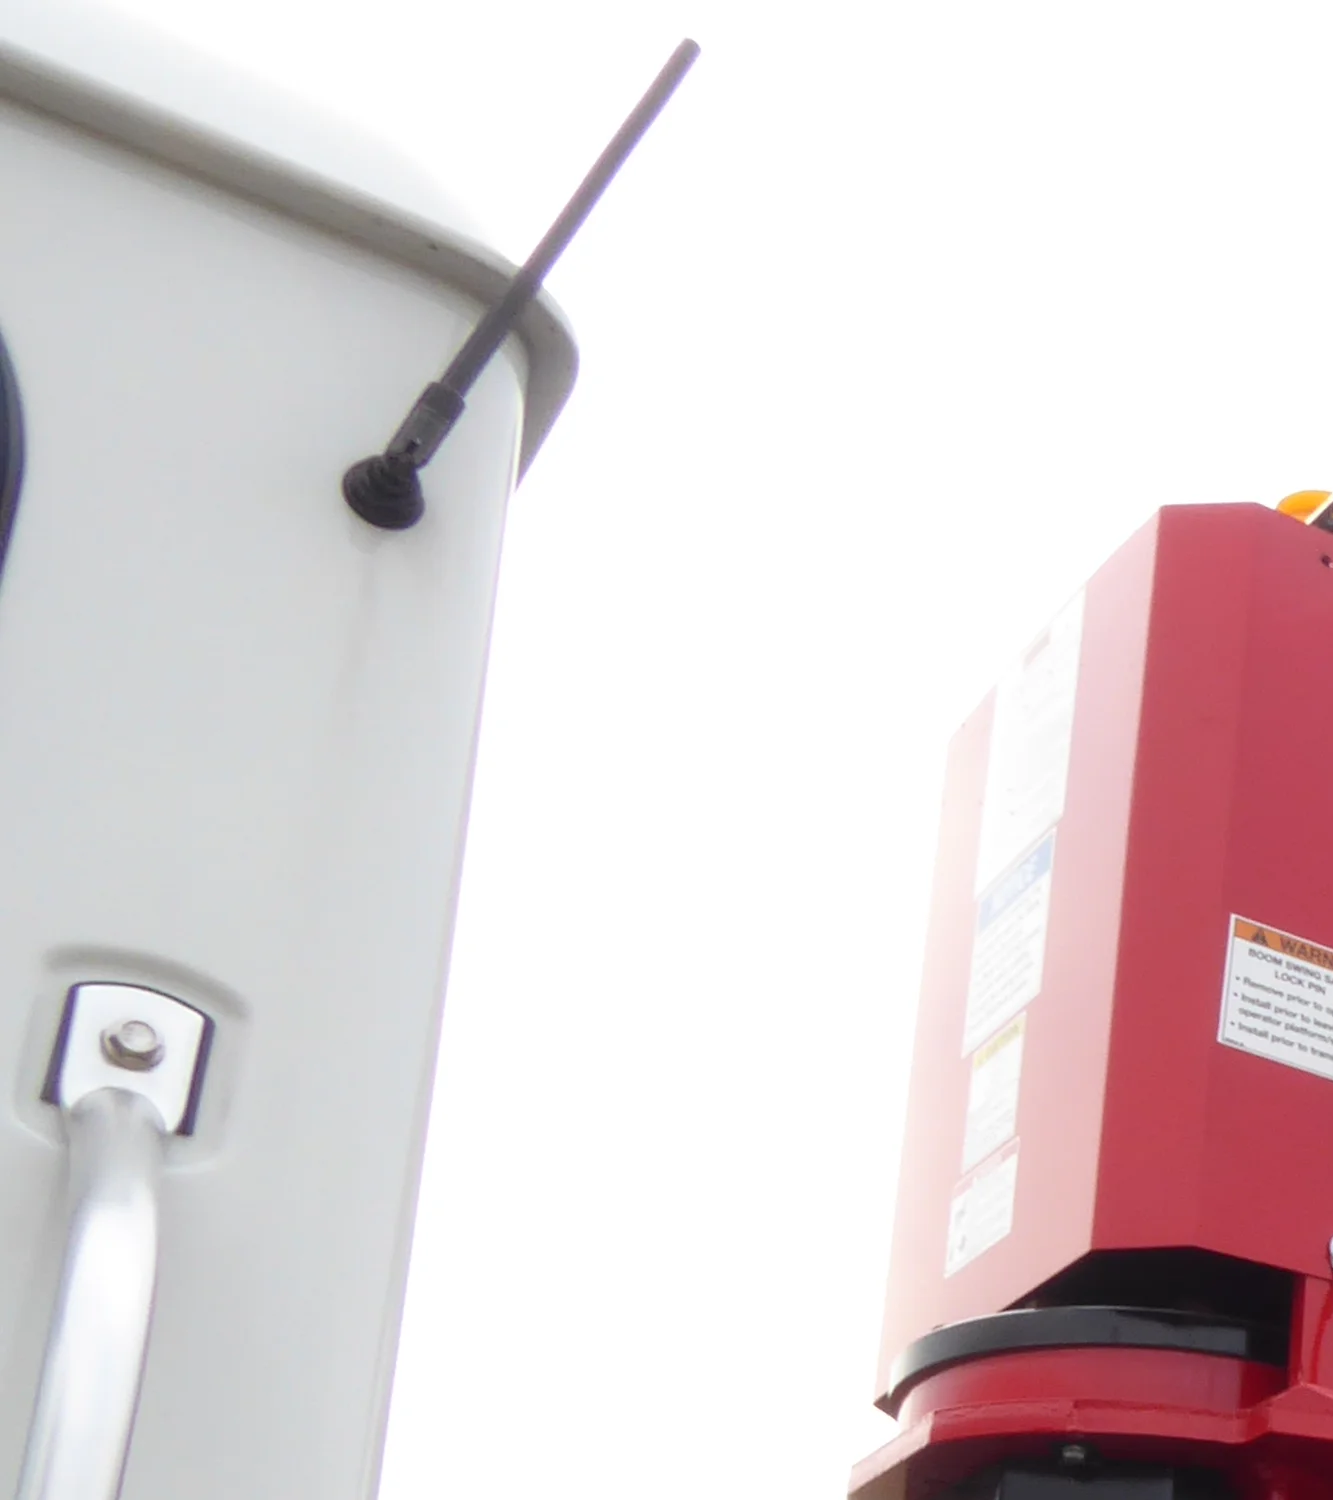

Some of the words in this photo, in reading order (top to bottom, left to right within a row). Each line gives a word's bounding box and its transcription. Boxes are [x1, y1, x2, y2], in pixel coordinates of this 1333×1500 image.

[1247, 947, 1282, 967] BOOM
[1285, 960, 1321, 980] SWING
[1242, 976, 1284, 998] Remove
[1286, 992, 1310, 1008] prior
[1273, 969, 1304, 987] LOCK
[1307, 981, 1326, 995] PIN
[1240, 992, 1271, 1010] Install
[1273, 1005, 1297, 1020] prior
[1237, 1021, 1269, 1039] Install
[1270, 1034, 1294, 1049] prior
